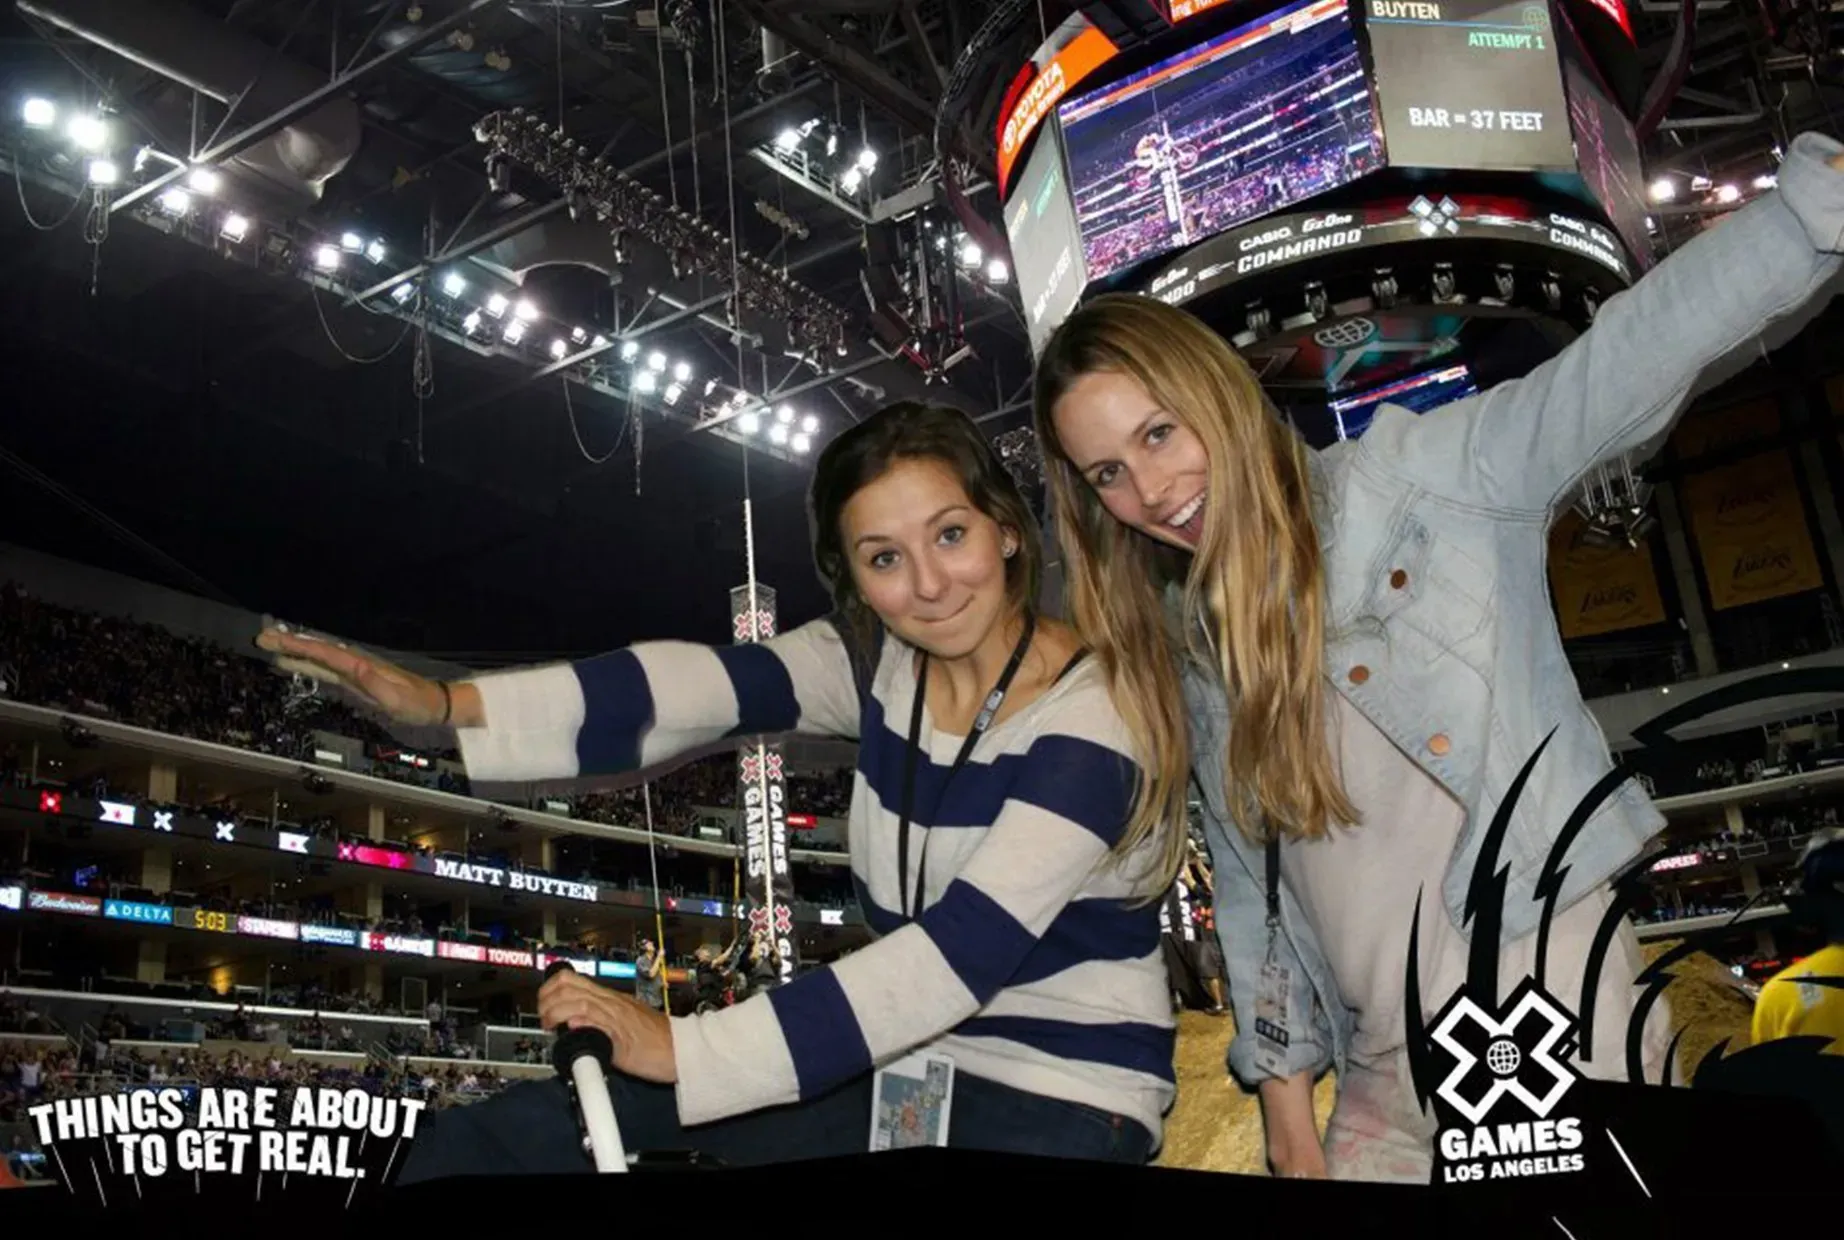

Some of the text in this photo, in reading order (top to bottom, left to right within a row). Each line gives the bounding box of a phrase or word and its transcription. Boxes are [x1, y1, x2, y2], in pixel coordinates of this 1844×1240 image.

[1372, 0, 1440, 20] BUYTEN
[1468, 32, 1545, 49] ATTEMPT 1
[1408, 107, 1450, 128] BAR
[1470, 110, 1495, 129] 37
[1500, 112, 1544, 131] FEET
[1237, 228, 1362, 274] COMMANDO
[1239, 226, 1293, 252] CASIO
[744, 786, 766, 878] GAMES
[769, 784, 788, 875] GAMES
[434, 858, 599, 902] MATT BUYTEN
[122, 905, 172, 921] DELTA
[488, 948, 533, 967] TOYOTA
